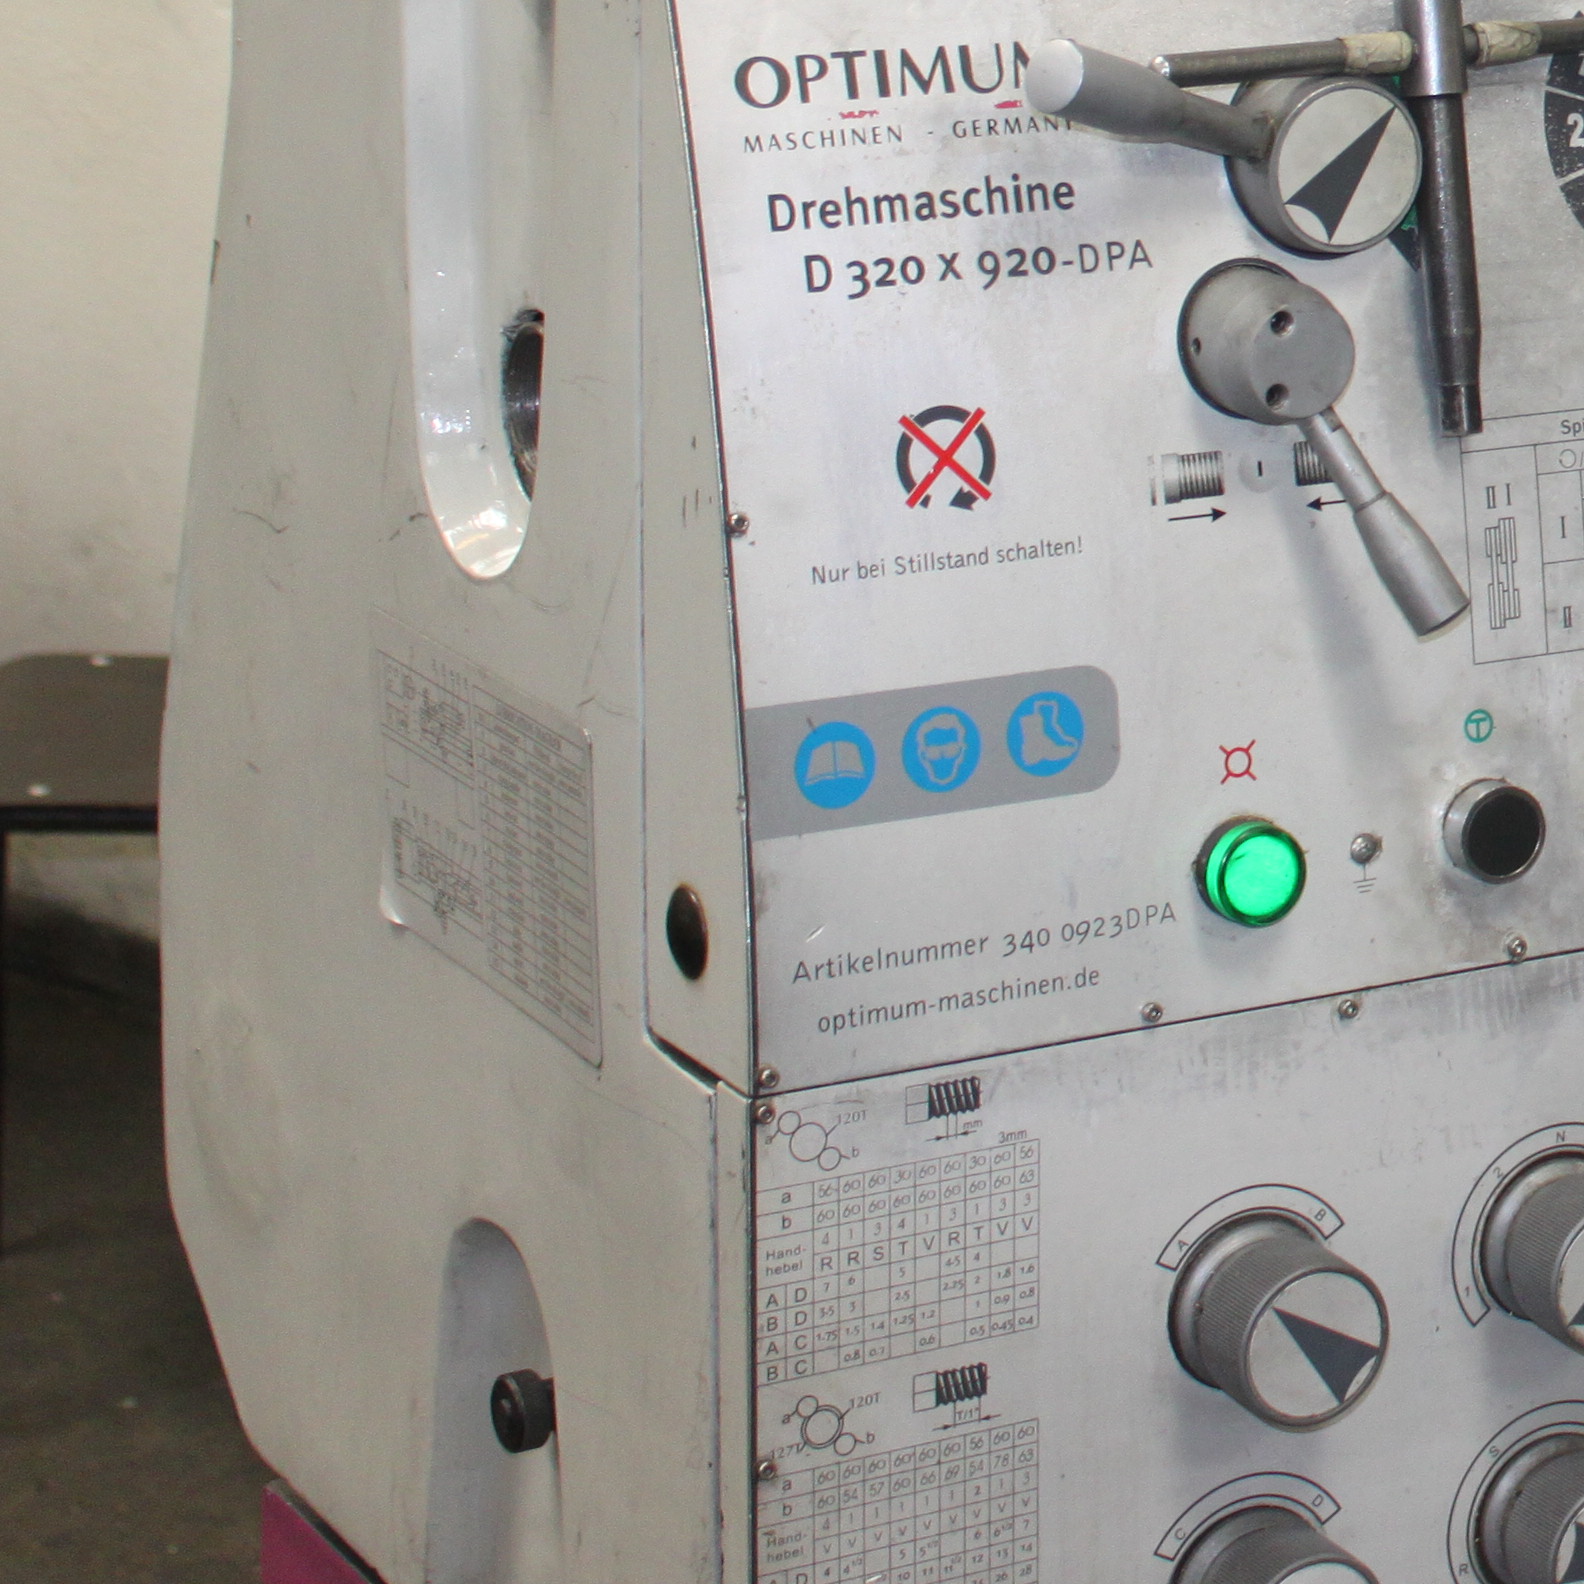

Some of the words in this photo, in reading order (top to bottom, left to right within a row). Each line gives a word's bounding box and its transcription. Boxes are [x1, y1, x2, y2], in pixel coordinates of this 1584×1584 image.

[743, 124, 903, 153] MASCHINEN
[768, 172, 1075, 233] Drehmaschine
[804, 254, 832, 294] D
[847, 254, 924, 299] 320
[811, 563, 848, 585] Nur
[857, 557, 886, 580] bei
[894, 546, 990, 576] Stillstand
[997, 536, 1083, 566] schalten!
[792, 933, 989, 985] Artikelnummer
[1002, 927, 1051, 959] 340
[817, 967, 1100, 1035] optimum-maschinen.de
[998, 1130, 1027, 1144] 3mm
[1556, 1131, 1566, 1142] N
[781, 1192, 791, 1204] a
[843, 1179, 860, 1193] 60
[868, 1174, 886, 1188] 60
[944, 1161, 960, 1174] 60
[994, 1151, 1011, 1165] 60
[782, 1215, 791, 1229] b
[817, 1209, 835, 1223] 60
[843, 1204, 860, 1218] 60
[868, 1199, 886, 1213] 60
[893, 1195, 911, 1208] 60
[918, 1190, 936, 1203] 60
[944, 1185, 961, 1198] 60
[969, 1180, 986, 1194] 60
[994, 1175, 1011, 1189] 60
[1314, 1208, 1327, 1221] B
[848, 1251, 860, 1265] R
[873, 1246, 884, 1261] S
[899, 1240, 908, 1255] T
[923, 1236, 935, 1250] V
[948, 1231, 960, 1246] R
[974, 1226, 984, 1240] T
[997, 1221, 1008, 1235] V
[1022, 1216, 1033, 1231] V
[1178, 1240, 1189, 1252] A
[766, 1244, 807, 1261] Hand-
[766, 1260, 803, 1276] hebel
[766, 1294, 779, 1308] A
[795, 1287, 807, 1302] D
[767, 1317, 778, 1332] B
[795, 1311, 807, 1326] D
[766, 1341, 779, 1356] A
[795, 1335, 807, 1350] C
[767, 1366, 778, 1381] B
[795, 1360, 807, 1375] C
[993, 1432, 1010, 1445] 60
[1017, 1426, 1034, 1439] 60
[1018, 1448, 1033, 1463] 63
[1489, 1445, 1500, 1458] S
[1311, 1494, 1324, 1507] D
[1174, 1528, 1186, 1541] C
[1458, 1563, 1468, 1575] R
